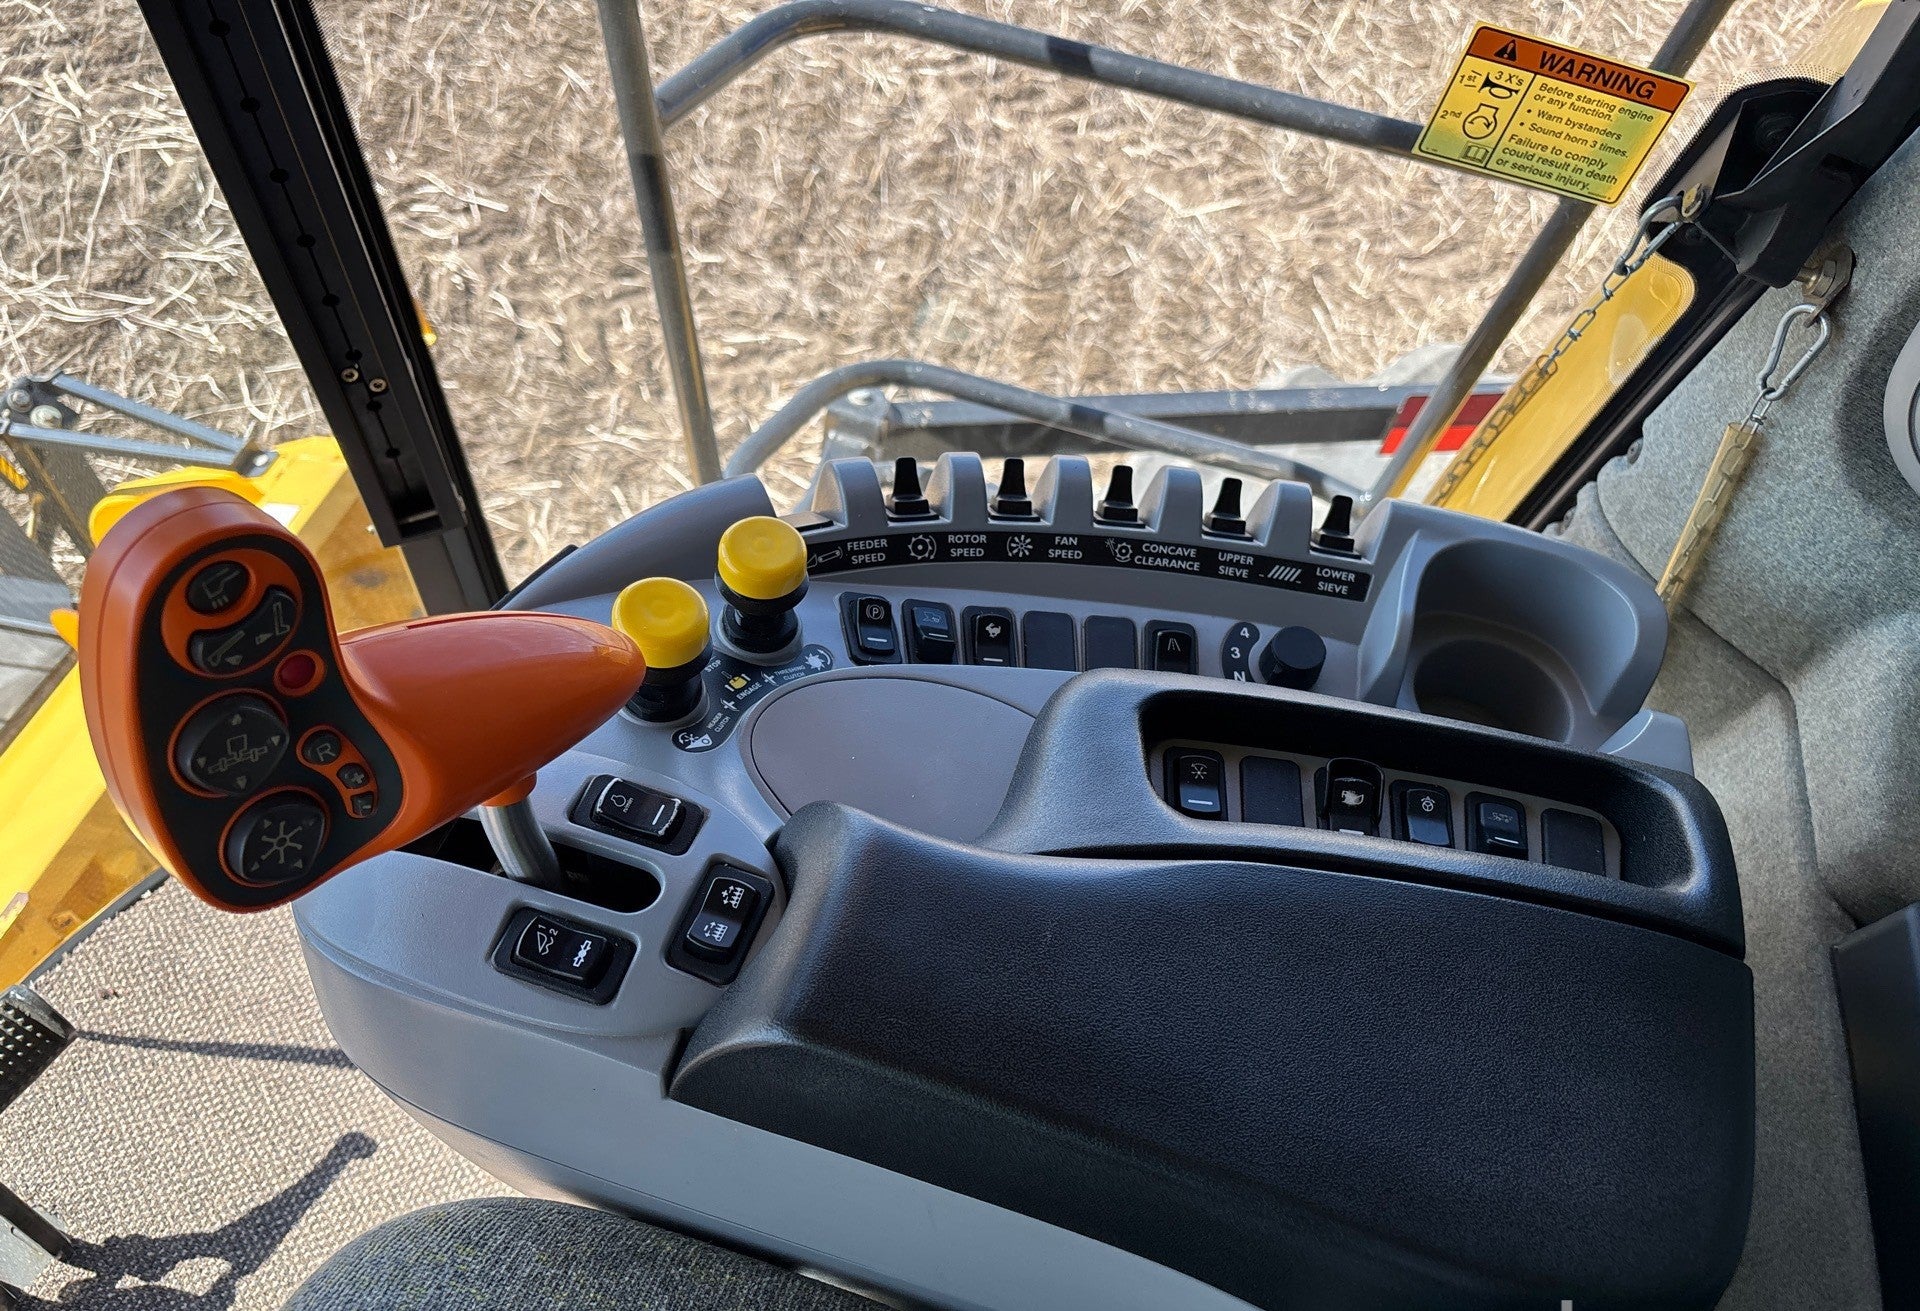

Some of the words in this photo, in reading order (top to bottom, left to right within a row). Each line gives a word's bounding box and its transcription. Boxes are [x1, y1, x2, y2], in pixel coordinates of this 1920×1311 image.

[1459, 74, 1477, 84] 1st
[1495, 71, 1504, 81] 3
[1539, 50, 1657, 100] WARNING
[1533, 93, 1546, 101] or
[1547, 97, 1567, 109] any
[1568, 102, 1613, 122] function.
[1539, 82, 1574, 100] Before
[1575, 94, 1617, 113] starting
[1618, 106, 1654, 123] engine
[1440, 109, 1462, 119] 2nd
[1537, 109, 1563, 124] Warn
[1564, 117, 1622, 141] bystanders
[1528, 122, 1562, 139] Sound
[1563, 131, 1588, 147] horn
[1589, 140, 1598, 149] 3
[1599, 142, 1629, 159] times.
[1508, 133, 1549, 153] Failure
[1550, 146, 1563, 156] to
[1564, 150, 1608, 171] comply
[1501, 146, 1536, 162] could
[1536, 155, 1571, 172] result
[1571, 164, 1584, 176] in
[1585, 167, 1618, 186] death
[1495, 157, 1509, 167] or
[1510, 160, 1554, 180] serious
[1555, 172, 1590, 191] injury.
[847, 538, 888, 552] FEEDER
[948, 534, 987, 545] ROTOR
[1055, 536, 1078, 547] FAN
[950, 547, 985, 558] SPEED
[1047, 548, 1083, 560] SPEED
[1141, 542, 1198, 559] CONCAVE
[851, 552, 886, 565] SPEED
[1134, 554, 1201, 572] CLEARANCE
[1217, 551, 1255, 567] UPPER
[1217, 564, 1250, 579] SIEVE
[1315, 566, 1356, 583] LOWER
[1317, 580, 1349, 596] SIEVE
[1240, 627, 1250, 639] 4
[1230, 647, 1241, 659] 3
[704, 659, 722, 673] STOP
[774, 664, 806, 677] THRESHING
[783, 671, 805, 681] CLUTCH
[1233, 671, 1246, 682] N
[736, 681, 763, 700] ENGAGE
[706, 712, 724, 730] HEADER
[714, 716, 731, 733] CLUTCH
[316, 742, 336, 762] R
[549, 928, 559, 936] 2
